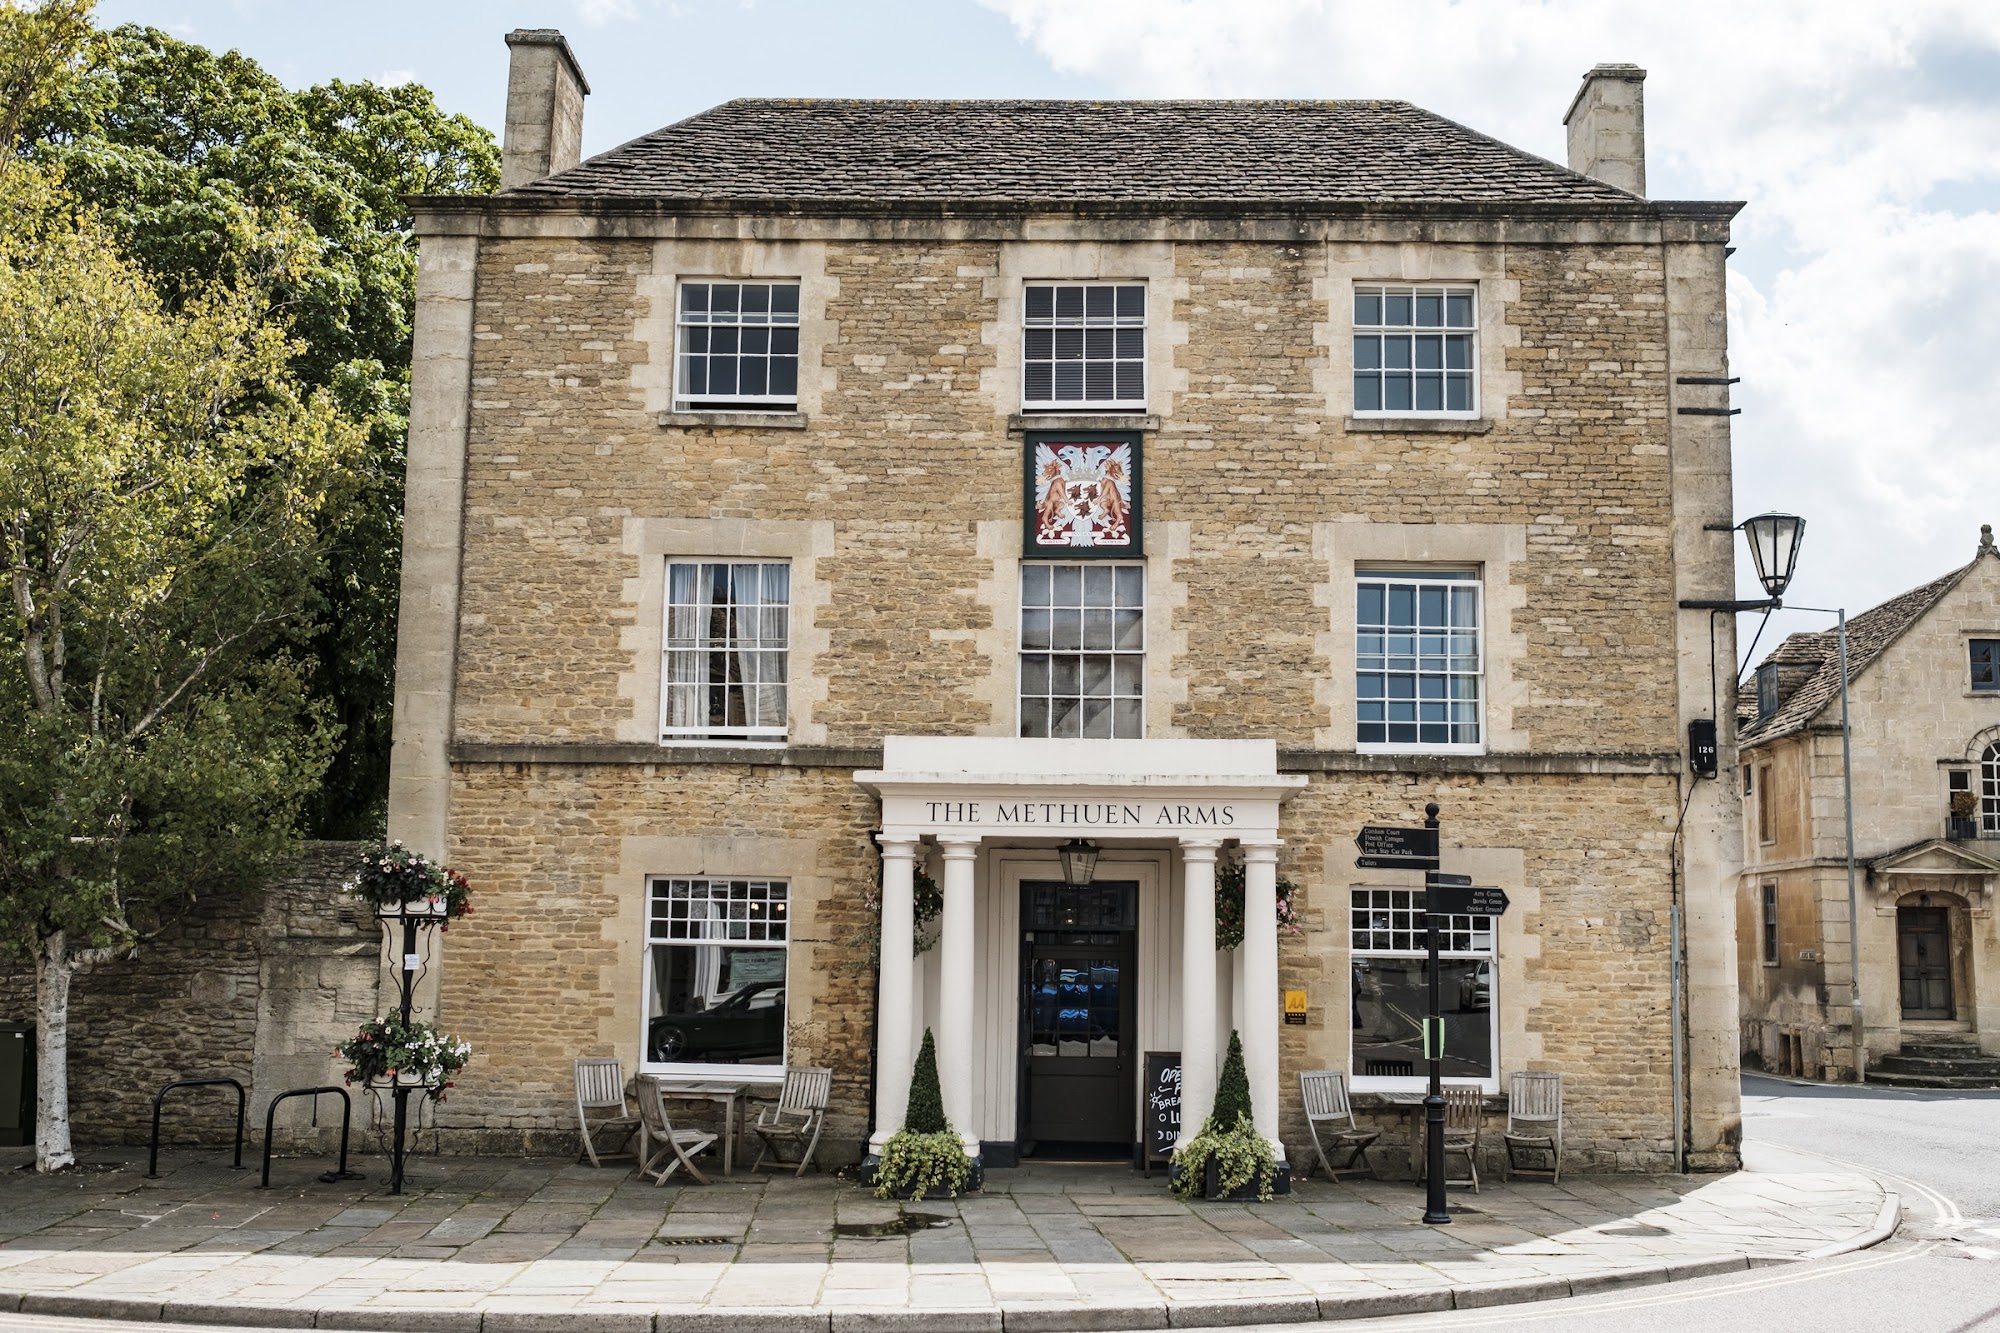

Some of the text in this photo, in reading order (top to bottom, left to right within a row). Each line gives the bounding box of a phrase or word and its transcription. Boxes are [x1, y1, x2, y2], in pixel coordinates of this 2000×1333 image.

[1698, 746, 1714, 754] 126
[925, 802, 1234, 825] THE METHUEN ARMS
[1288, 997, 1305, 1009] AA
